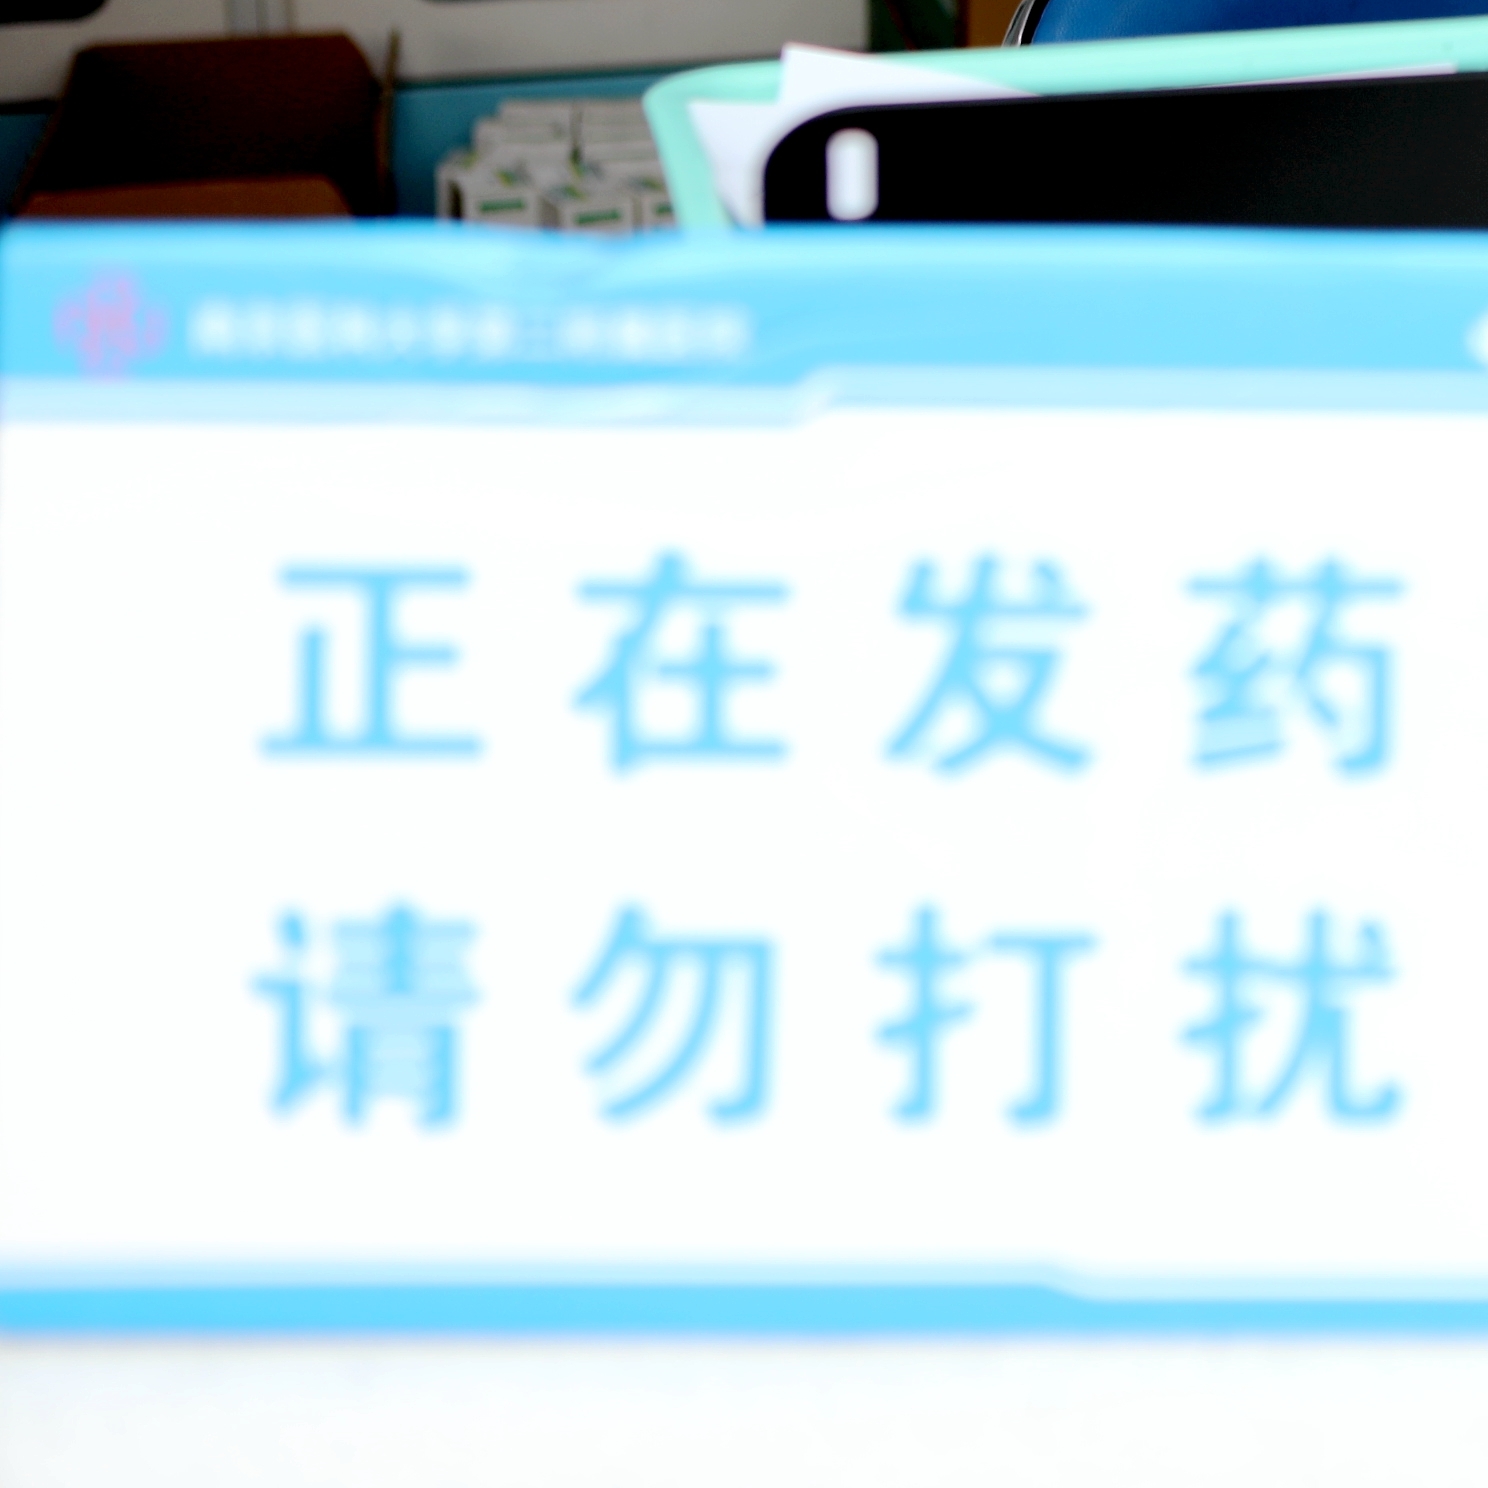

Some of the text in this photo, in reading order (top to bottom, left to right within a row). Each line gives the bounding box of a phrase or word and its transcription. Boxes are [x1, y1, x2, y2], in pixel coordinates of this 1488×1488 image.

[257, 548, 1409, 777] 正在发药
[250, 900, 1407, 1131] 请勿打扰
